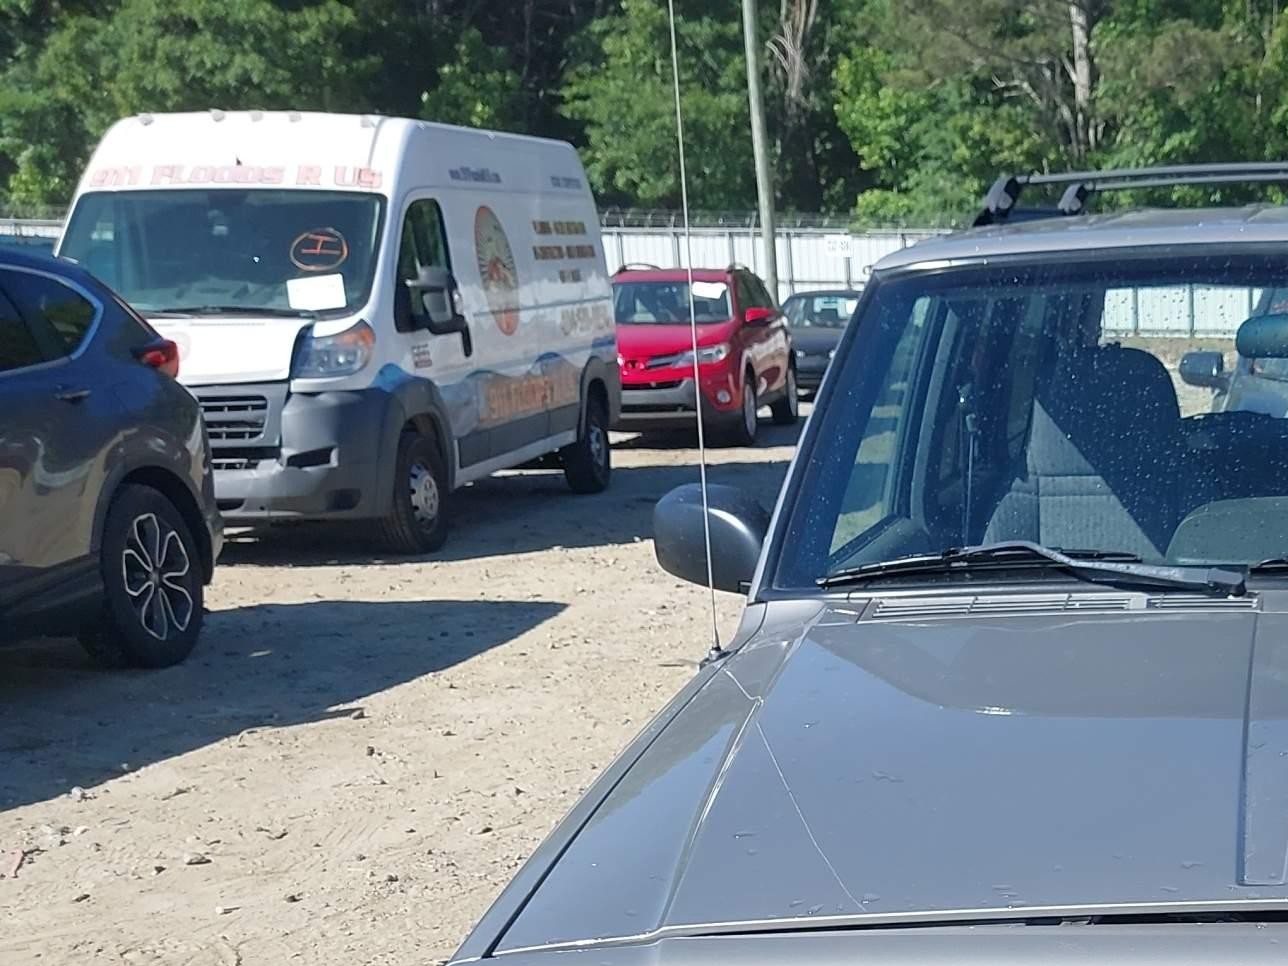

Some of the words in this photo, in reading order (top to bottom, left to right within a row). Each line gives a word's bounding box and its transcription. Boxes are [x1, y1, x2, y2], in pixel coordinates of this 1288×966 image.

[150, 164, 286, 185] FLOODS
[296, 164, 323, 186] R
[335, 165, 384, 189] US
